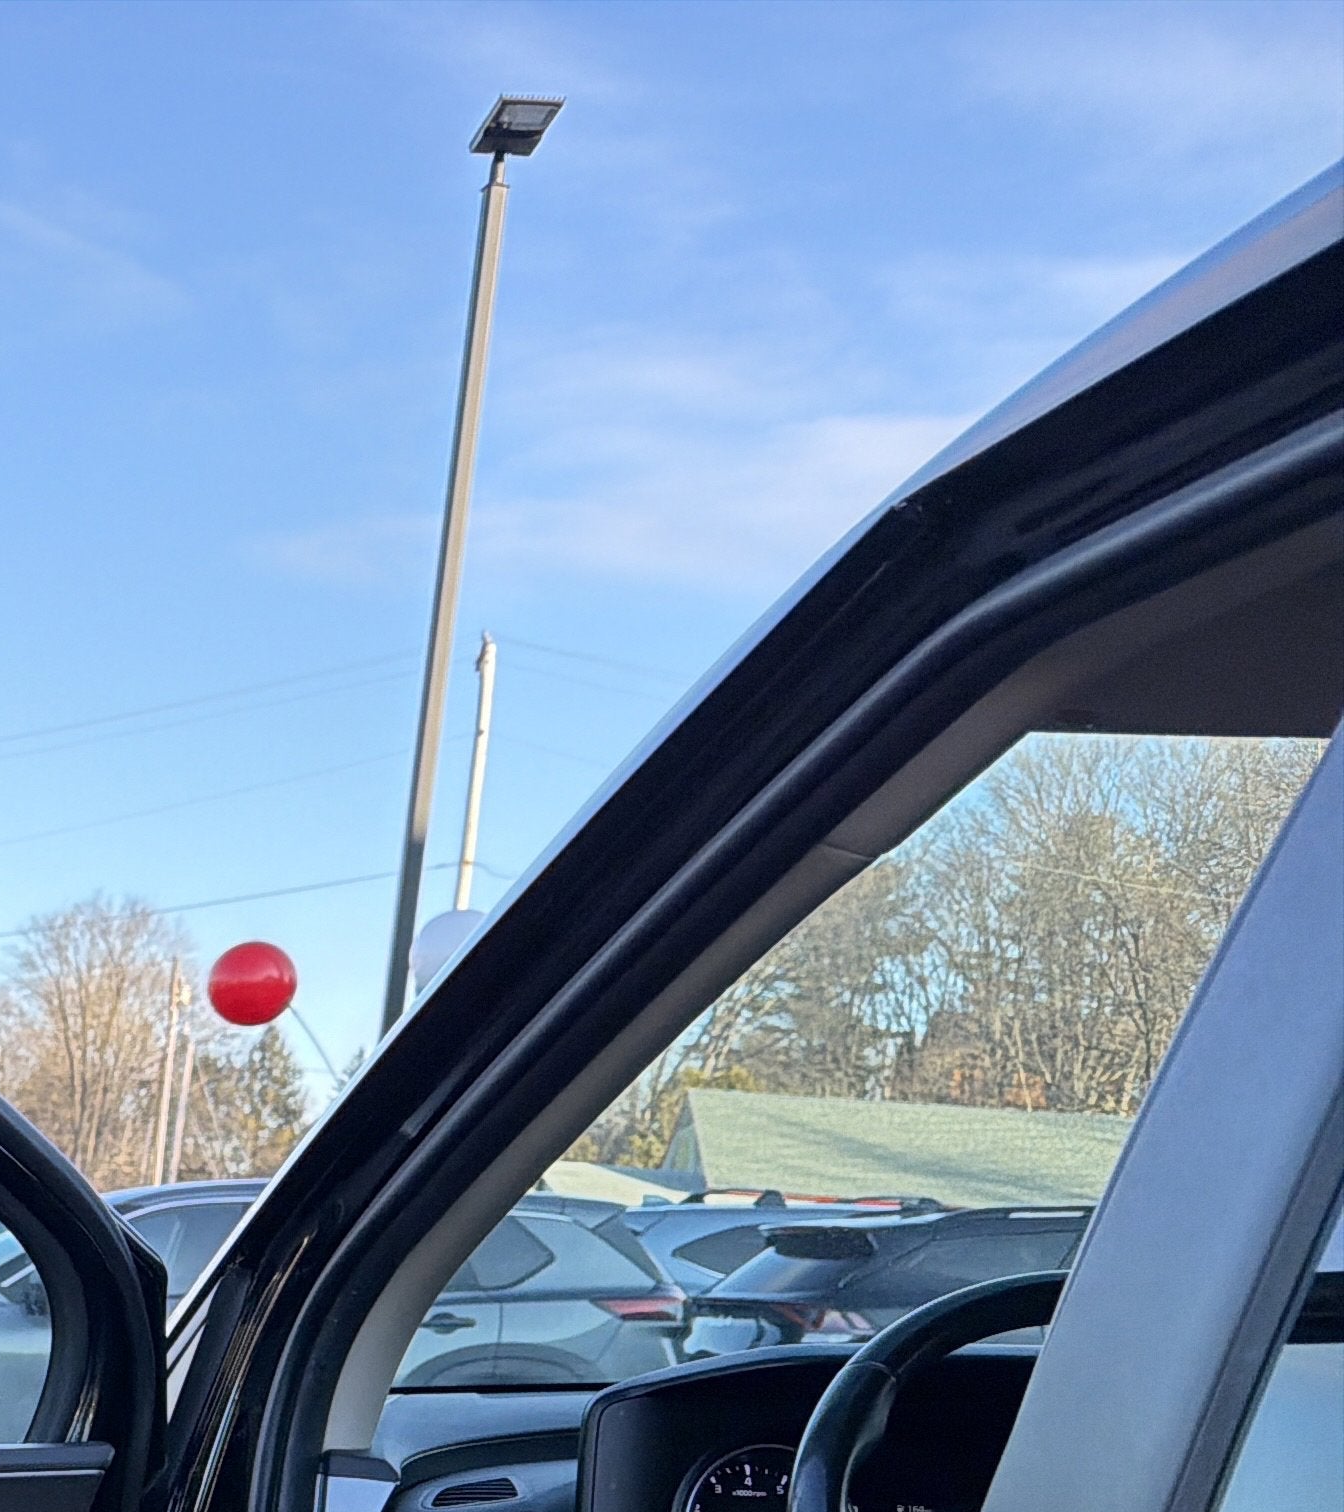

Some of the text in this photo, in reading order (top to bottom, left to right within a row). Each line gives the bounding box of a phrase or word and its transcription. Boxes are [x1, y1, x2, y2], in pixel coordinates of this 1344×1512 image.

[744, 1477, 752, 1486] 4
[714, 1484, 722, 1494] 3
[776, 1485, 785, 1495] 5
